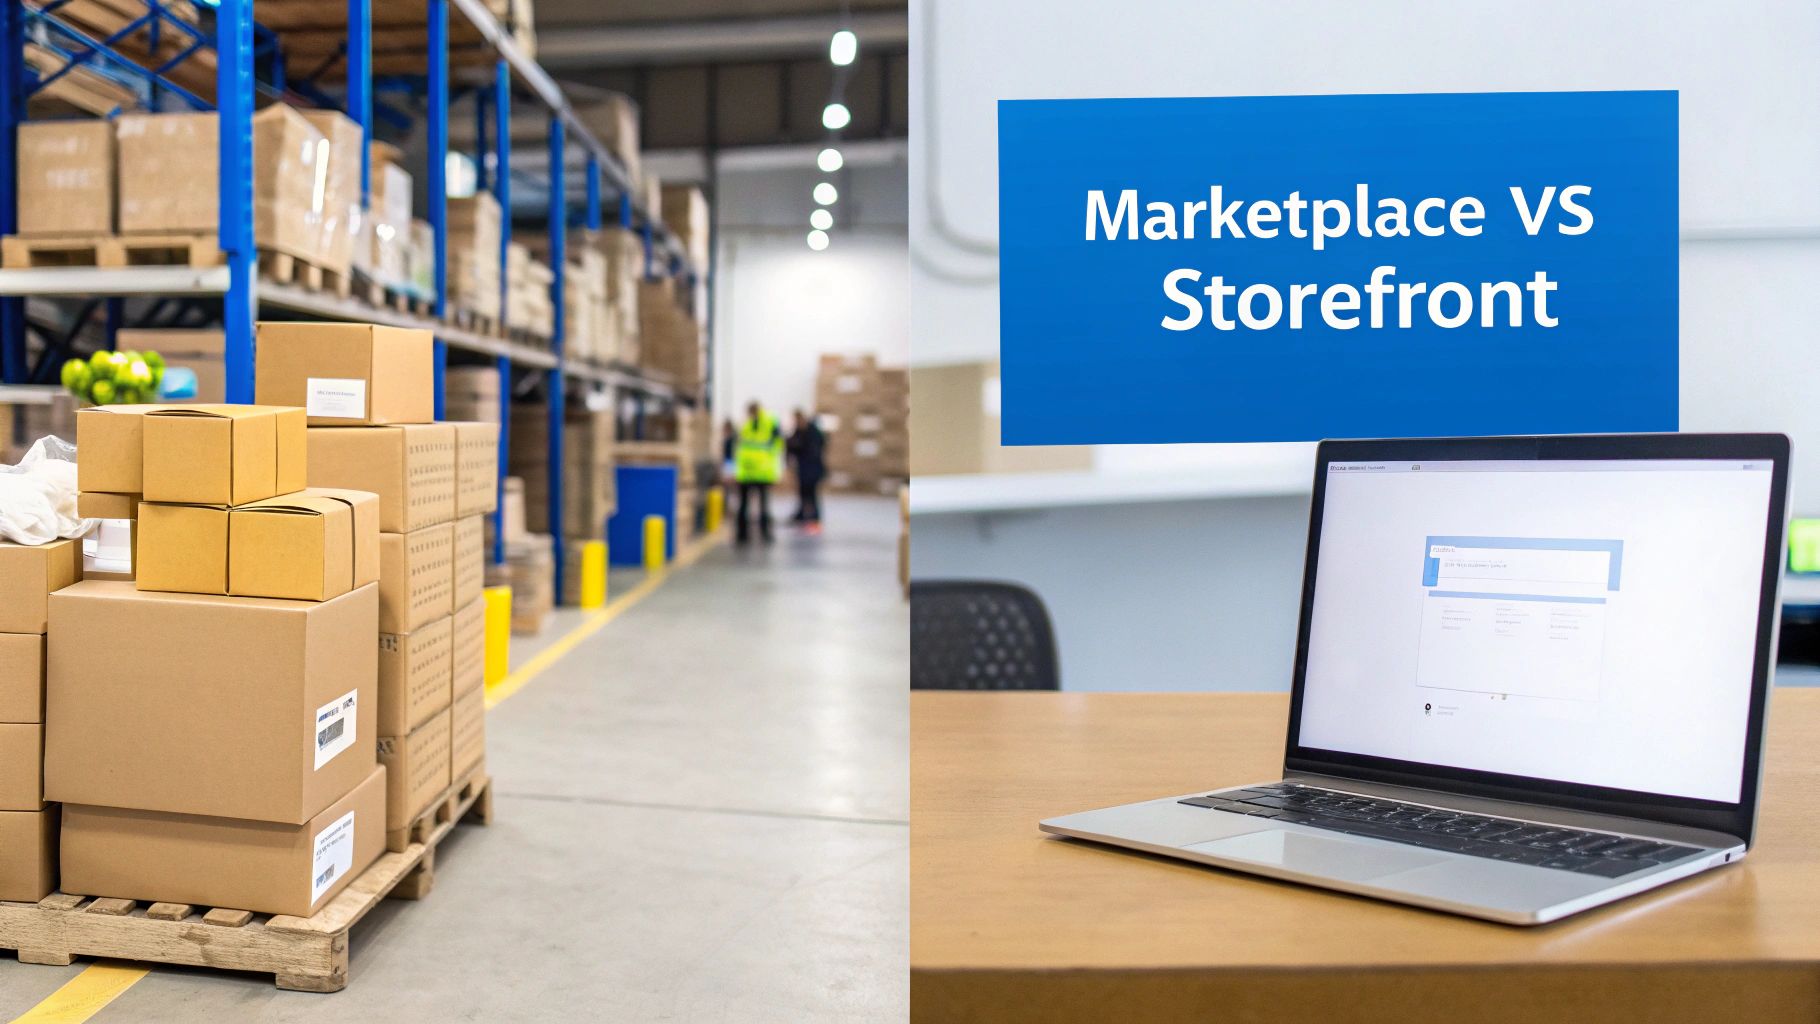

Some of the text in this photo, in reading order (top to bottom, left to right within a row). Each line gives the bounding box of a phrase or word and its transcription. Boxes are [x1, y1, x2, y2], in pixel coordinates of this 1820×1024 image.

[1085, 184, 1594, 251] Marketplace VS
[1160, 266, 1559, 331] Storefront
